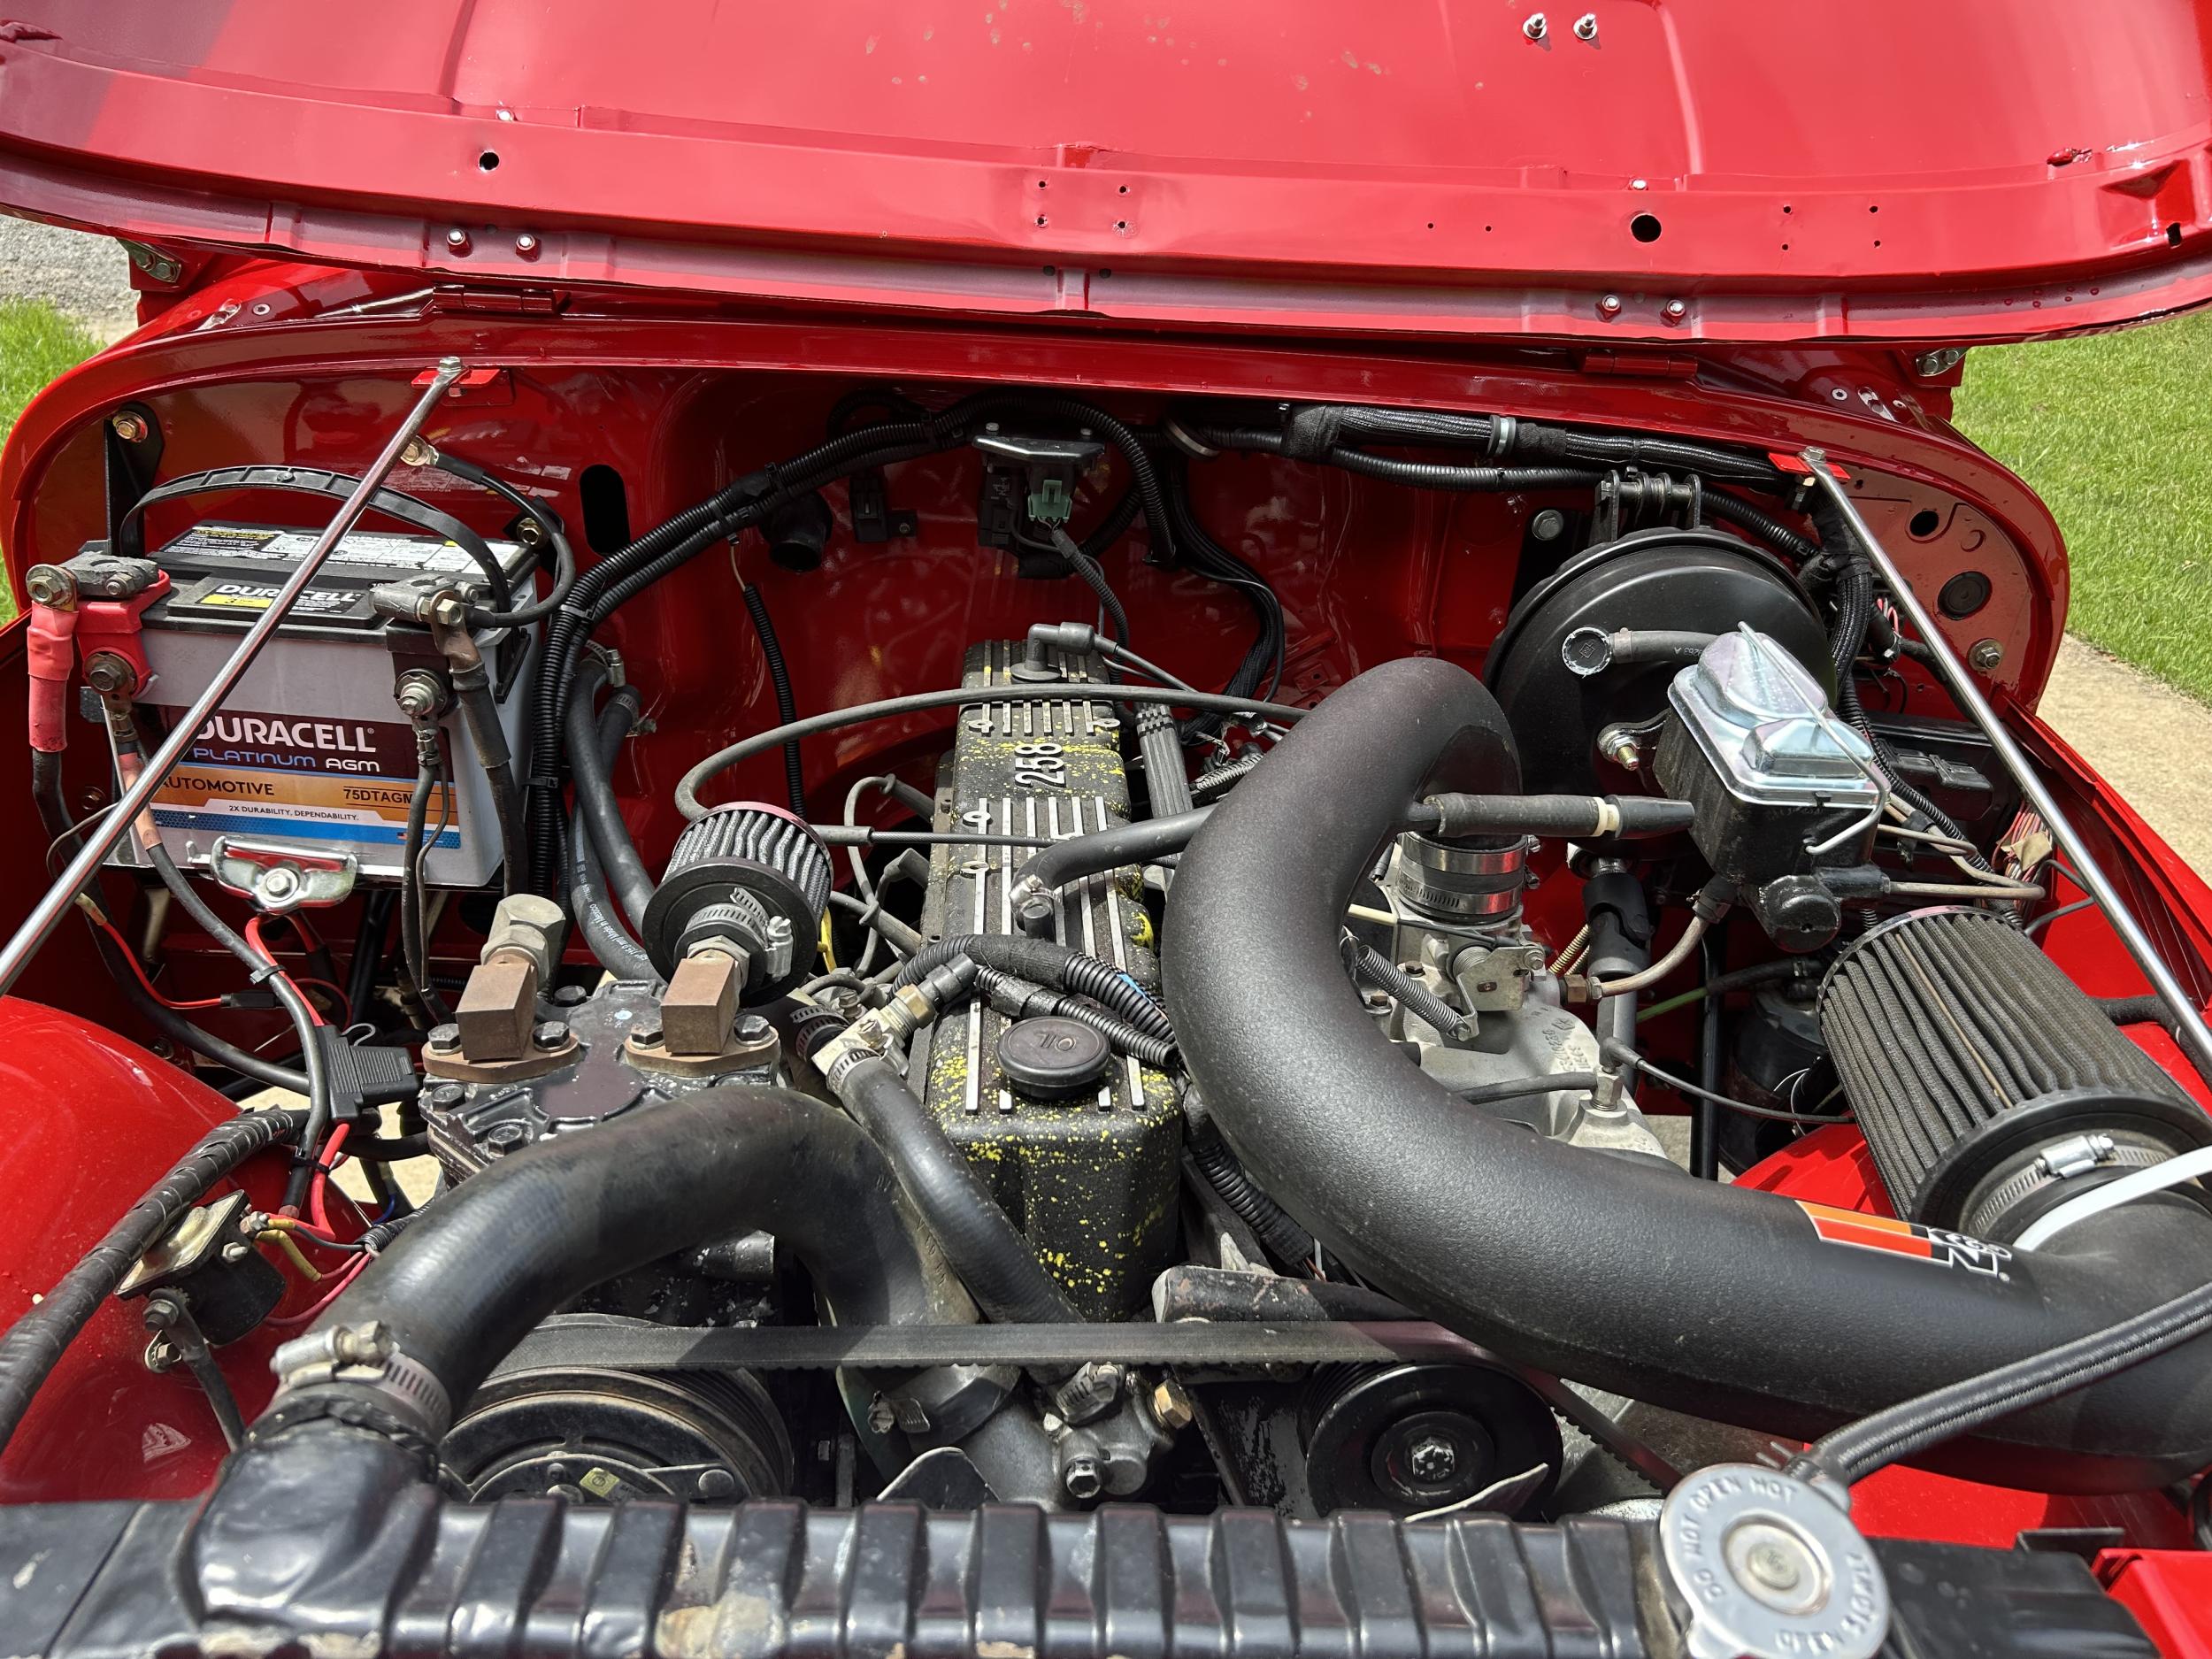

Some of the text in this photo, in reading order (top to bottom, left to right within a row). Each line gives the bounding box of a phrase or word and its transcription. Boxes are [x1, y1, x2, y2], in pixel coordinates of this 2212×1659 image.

[216, 584, 356, 603] DURCELL
[193, 748, 380, 772] PLATINUM AGM
[1015, 743, 1066, 788] 258
[1679, 1475, 1799, 1601] DO NOT OPEN HOT
